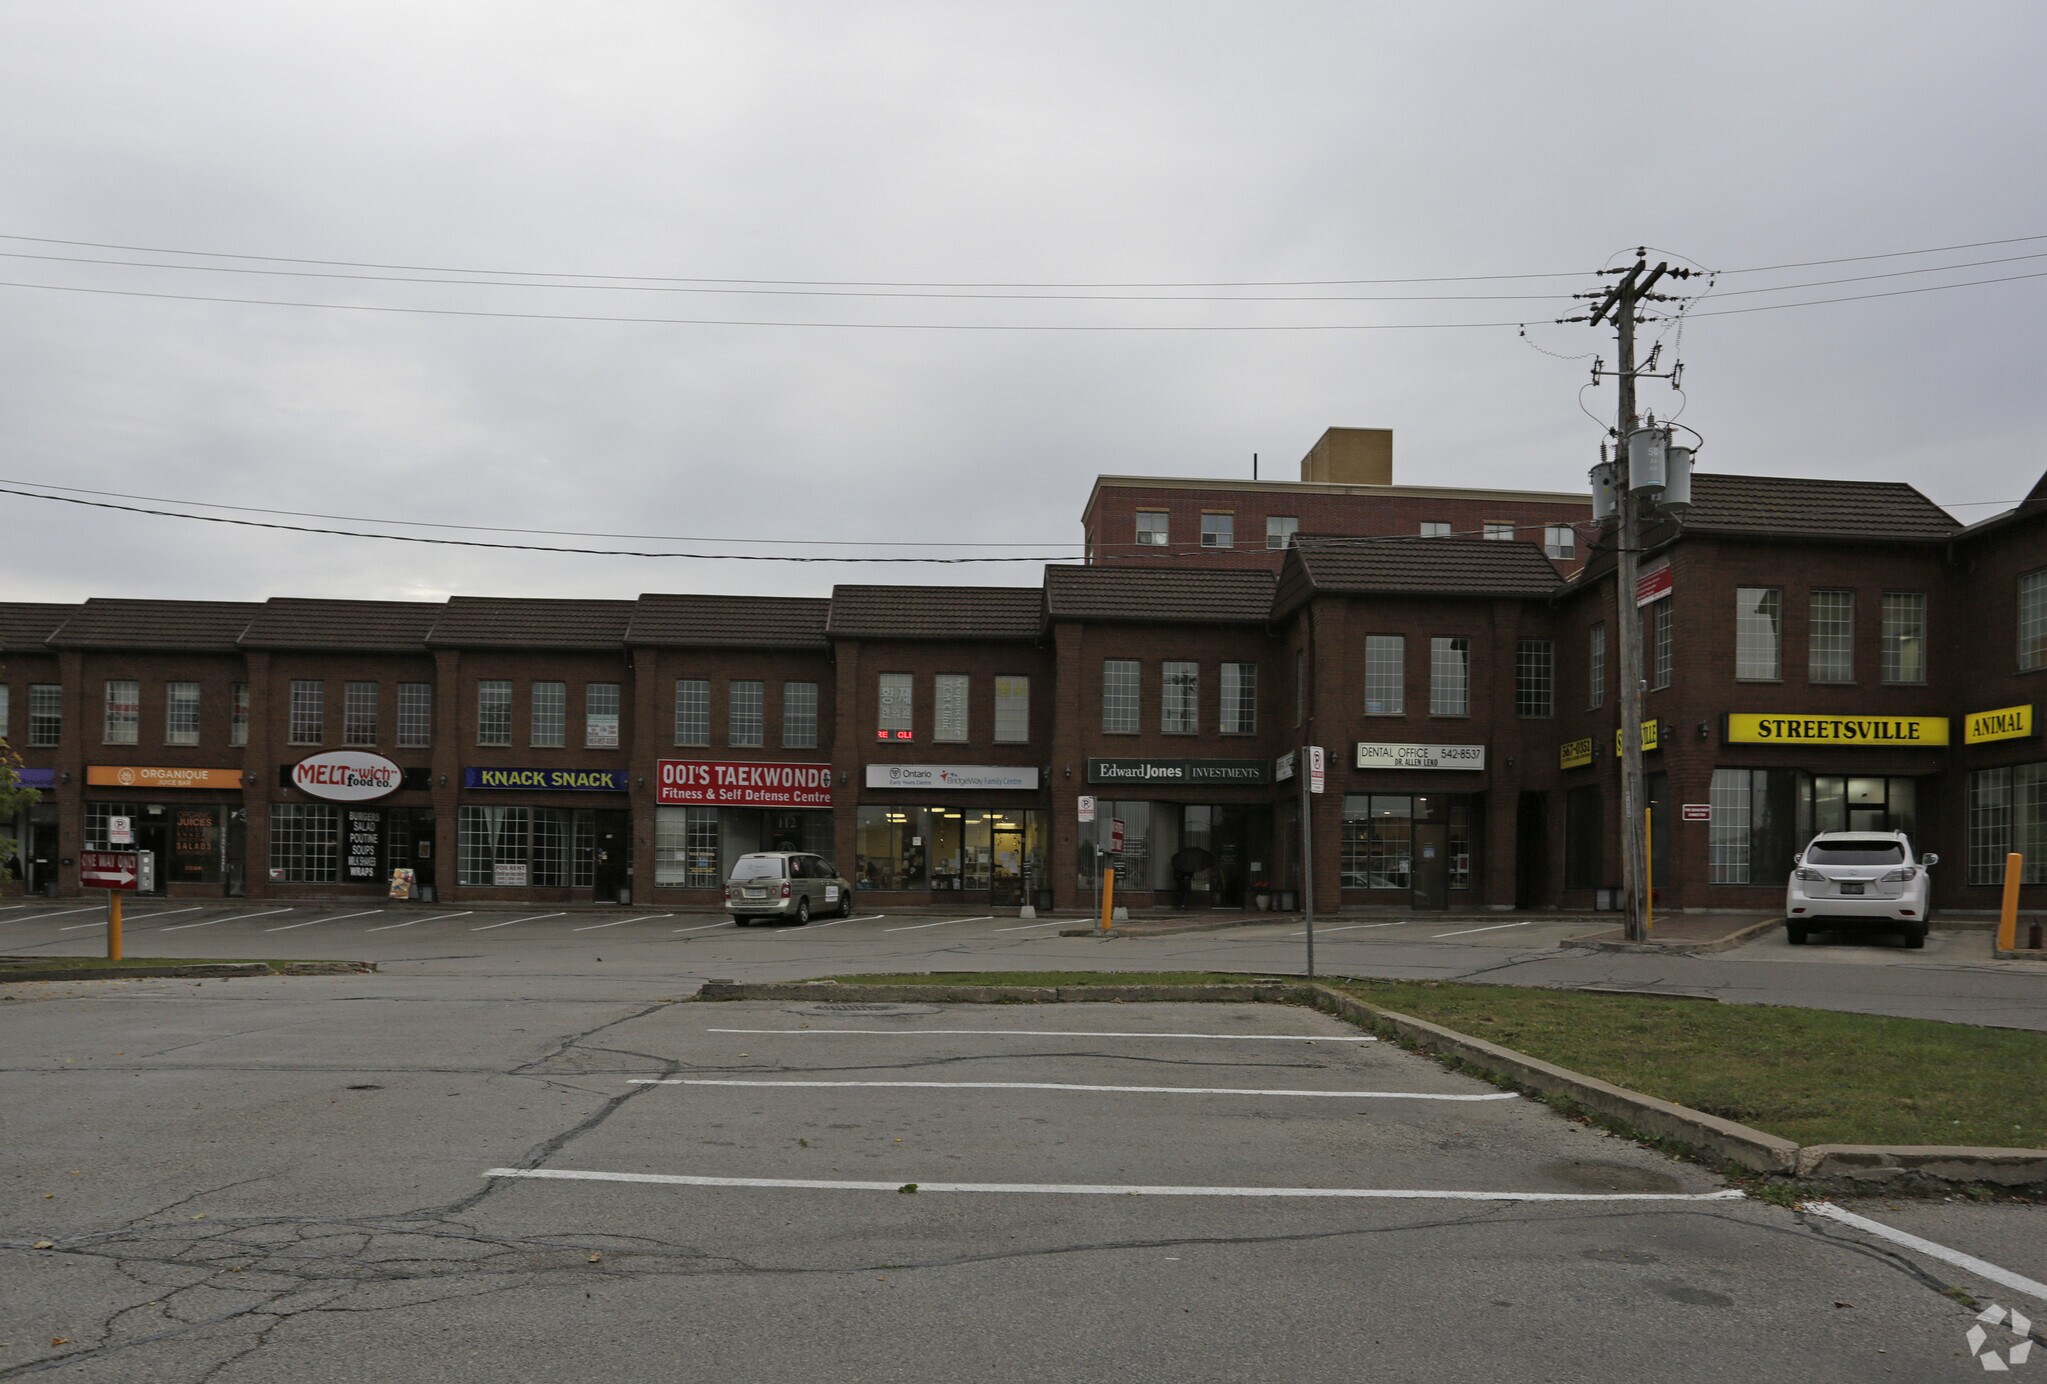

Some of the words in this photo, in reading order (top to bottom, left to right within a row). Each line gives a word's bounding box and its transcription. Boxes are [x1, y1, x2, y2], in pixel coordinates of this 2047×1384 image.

[1758, 720, 1920, 740] STREETSVILLE
[1972, 712, 2024, 737] ANIMAL
[1361, 747, 1393, 757] DENTAL
[1398, 748, 1428, 759] OFFICE
[1441, 749, 1480, 759] 542-8537
[1405, 758, 1422, 767] ALLEN
[140, 769, 209, 780] ORGANIQUE
[903, 769, 932, 778] Ontario
[1192, 768, 1260, 778] INVESTMENTS
[347, 773, 373, 787] food
[376, 780, 393, 788] co.
[482, 770, 548, 788] KNACK
[551, 772, 615, 789] SNACK
[947, 777, 983, 787] BridgeWay
[984, 778, 1002, 787] Family
[1003, 777, 1023, 786] Centre
[662, 787, 703, 800] Fitness
[706, 789, 716, 800] &
[719, 789, 742, 801] Self
[745, 790, 790, 802] Defense
[793, 790, 831, 803] Centre
[177, 818, 212, 826] JUICES
[353, 821, 376, 832] SALAD
[777, 817, 797, 829] 112
[349, 833, 378, 844] POUTINE
[176, 842, 212, 850] SALADS
[351, 844, 375, 855] SOUPS
[350, 866, 374, 877] WRAPS
